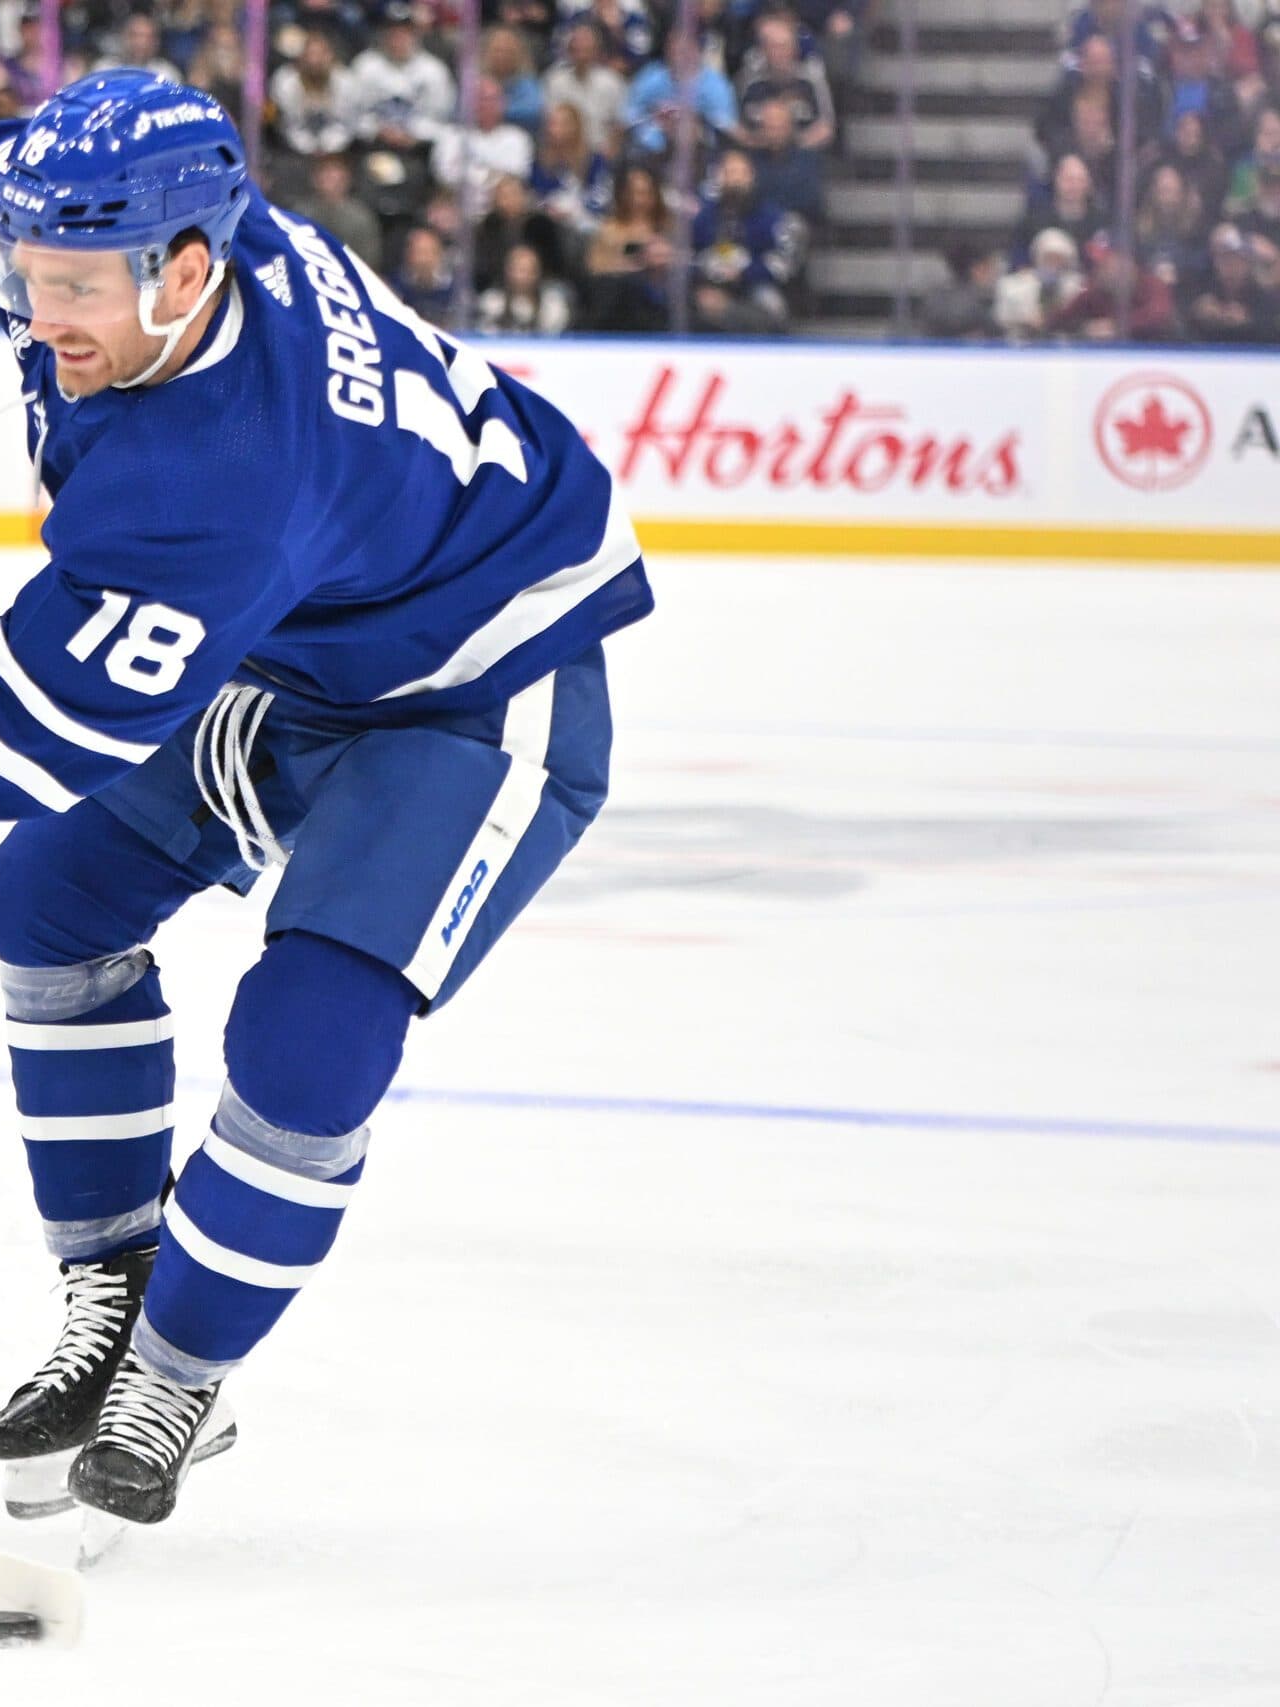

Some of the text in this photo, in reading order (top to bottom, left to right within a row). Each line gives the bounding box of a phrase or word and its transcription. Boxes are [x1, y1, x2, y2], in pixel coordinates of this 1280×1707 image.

[17, 125, 58, 167] 18
[2, 184, 46, 213] CCM
[617, 362, 1022, 498] Hortons
[65, 589, 207, 696] 18
[441, 859, 489, 948] CCM
